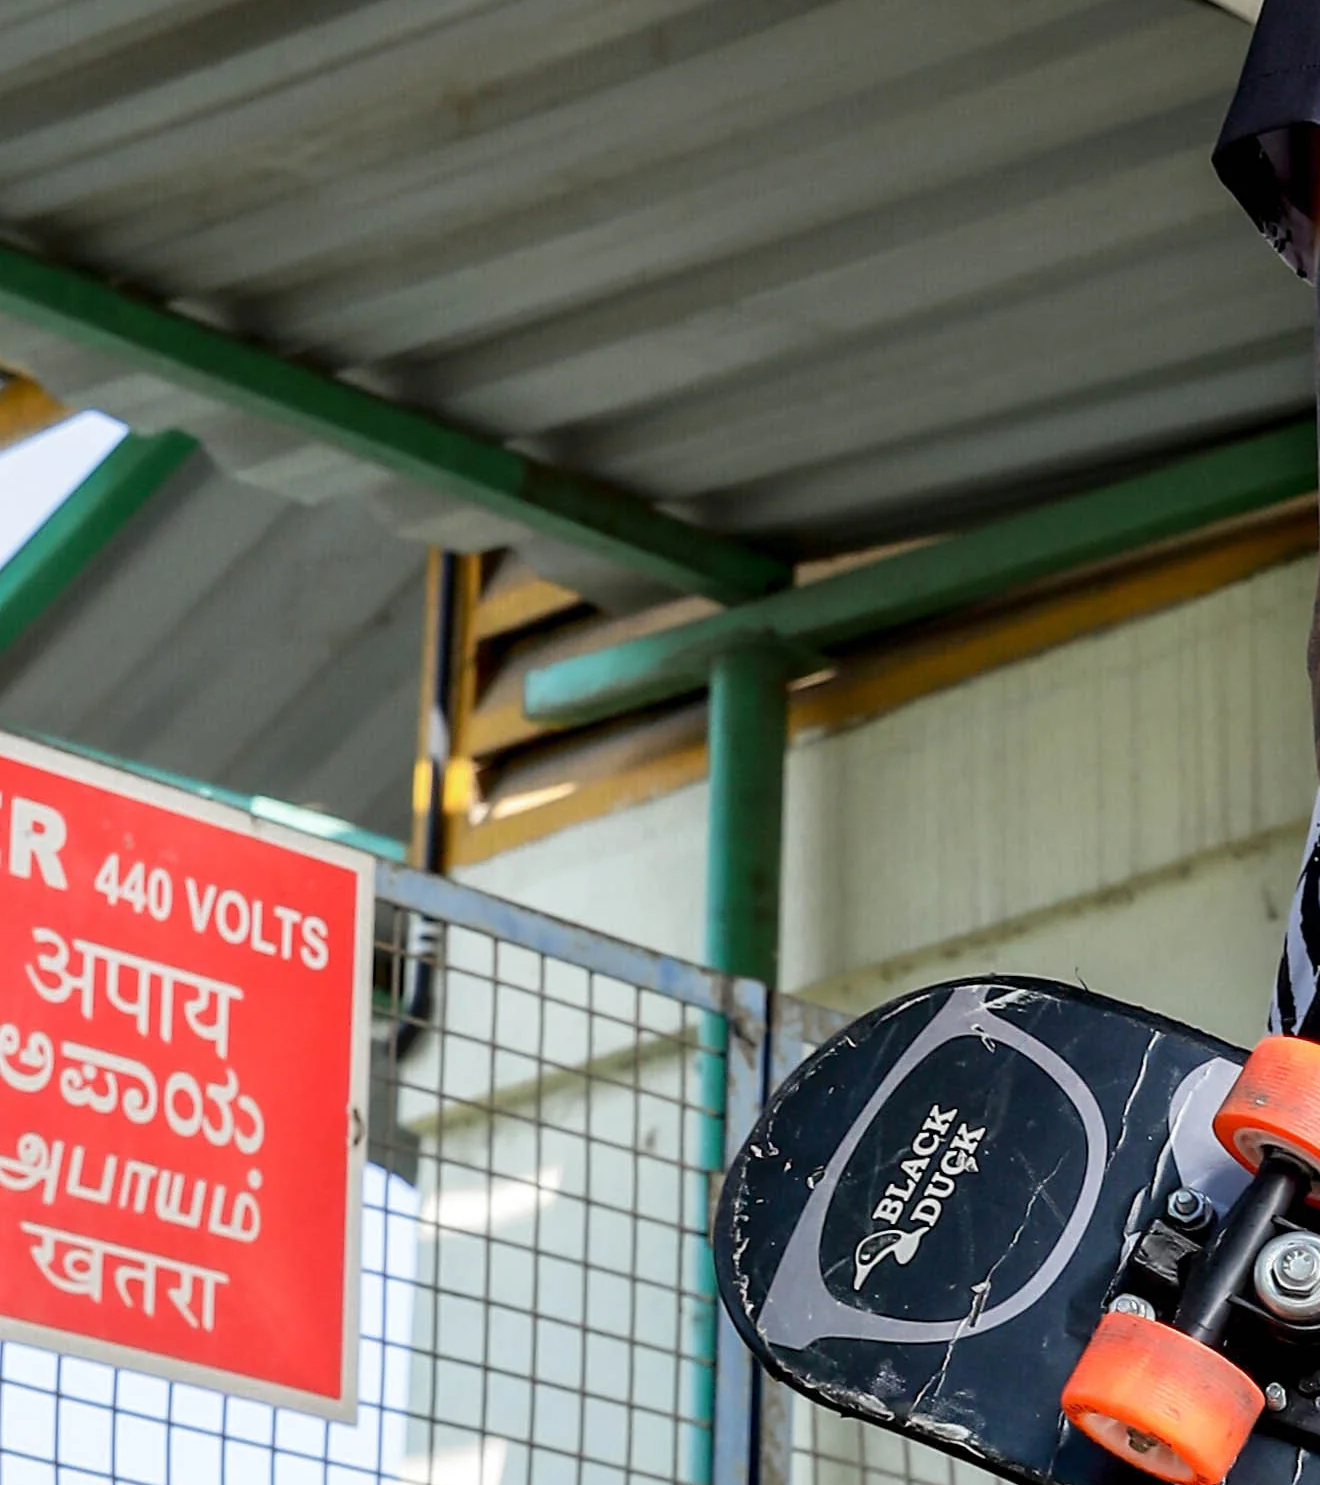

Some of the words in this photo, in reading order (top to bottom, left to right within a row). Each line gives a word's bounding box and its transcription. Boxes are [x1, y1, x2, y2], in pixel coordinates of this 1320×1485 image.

[0, 793, 69, 891] R
[94, 852, 173, 922] 440
[185, 876, 329, 970] VOLTS
[25, 927, 245, 1060] अपाय
[871, 1104, 958, 1225] BLACK
[909, 1123, 986, 1227] DUCK
[20, 1220, 230, 1332] खतरा
